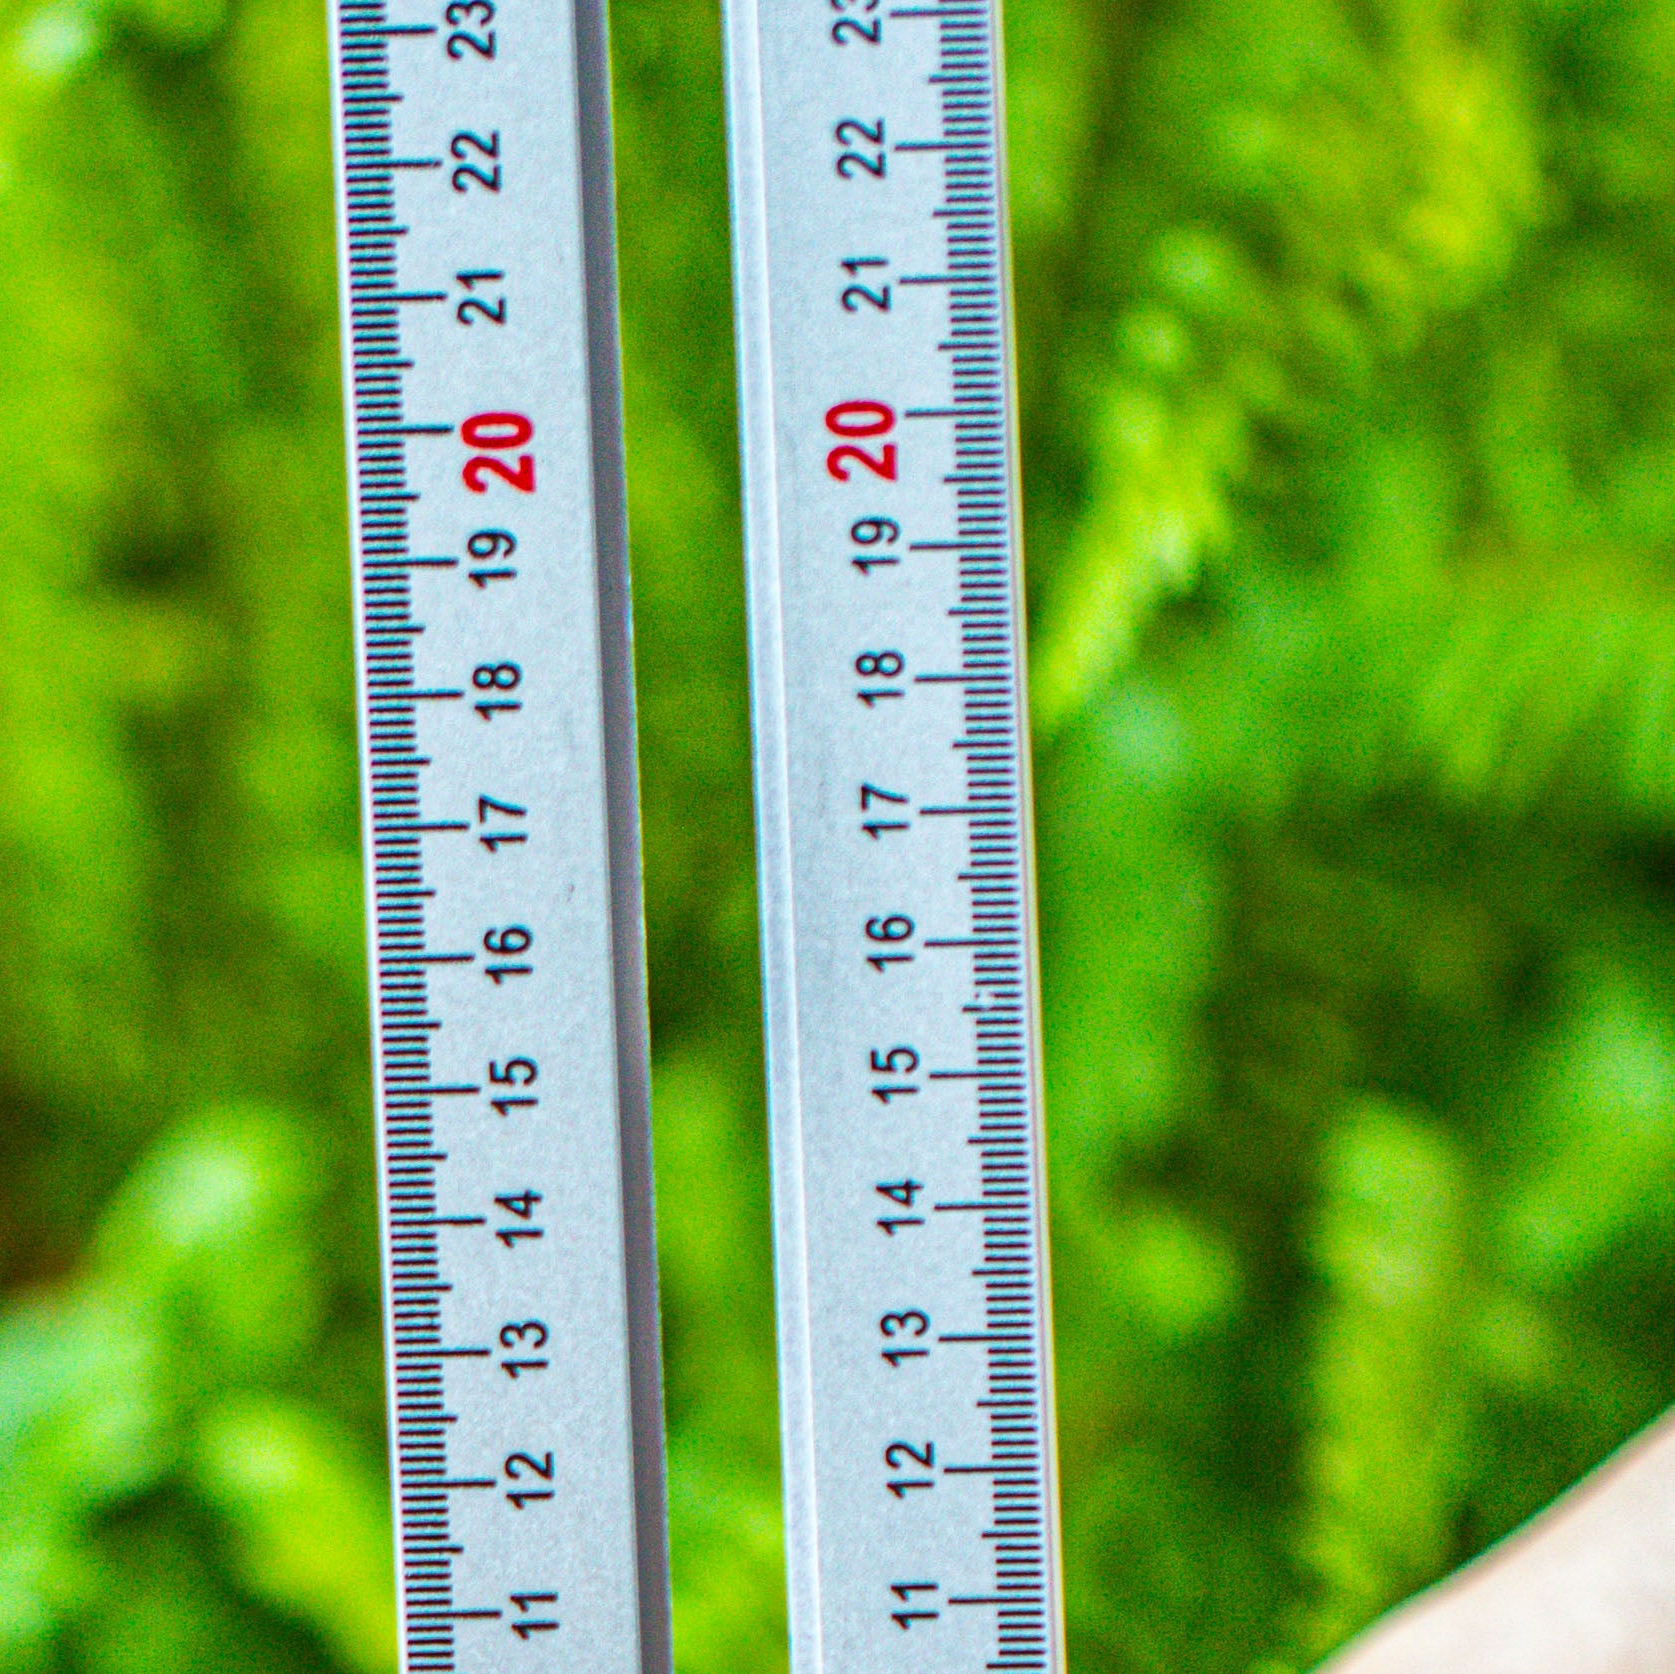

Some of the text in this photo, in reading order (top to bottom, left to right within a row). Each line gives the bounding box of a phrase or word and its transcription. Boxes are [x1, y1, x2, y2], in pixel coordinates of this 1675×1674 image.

[444, 0, 495, 61] 23
[450, 132, 500, 193] 22
[834, 120, 886, 179] 22
[455, 272, 506, 326] 21
[840, 259, 890, 313] 21
[460, 411, 536, 494] 20
[824, 399, 897, 482] 20
[466, 531, 517, 589] 19
[850, 518, 899, 575] 19
[471, 663, 521, 721] 18
[854, 651, 904, 708] 18
[477, 796, 527, 853] 17
[859, 784, 909, 840] 17
[482, 927, 533, 985] 16
[864, 915, 914, 973] 16
[488, 1058, 538, 1117] 15
[869, 1047, 919, 1104] 15
[493, 1190, 544, 1248] 14
[875, 1180, 924, 1236] 14
[499, 1321, 548, 1379] 13
[879, 1310, 929, 1368] 13
[503, 1452, 554, 1510] 12
[884, 1442, 934, 1499] 12
[509, 1593, 559, 1640] 11
[890, 1583, 939, 1630] 11
